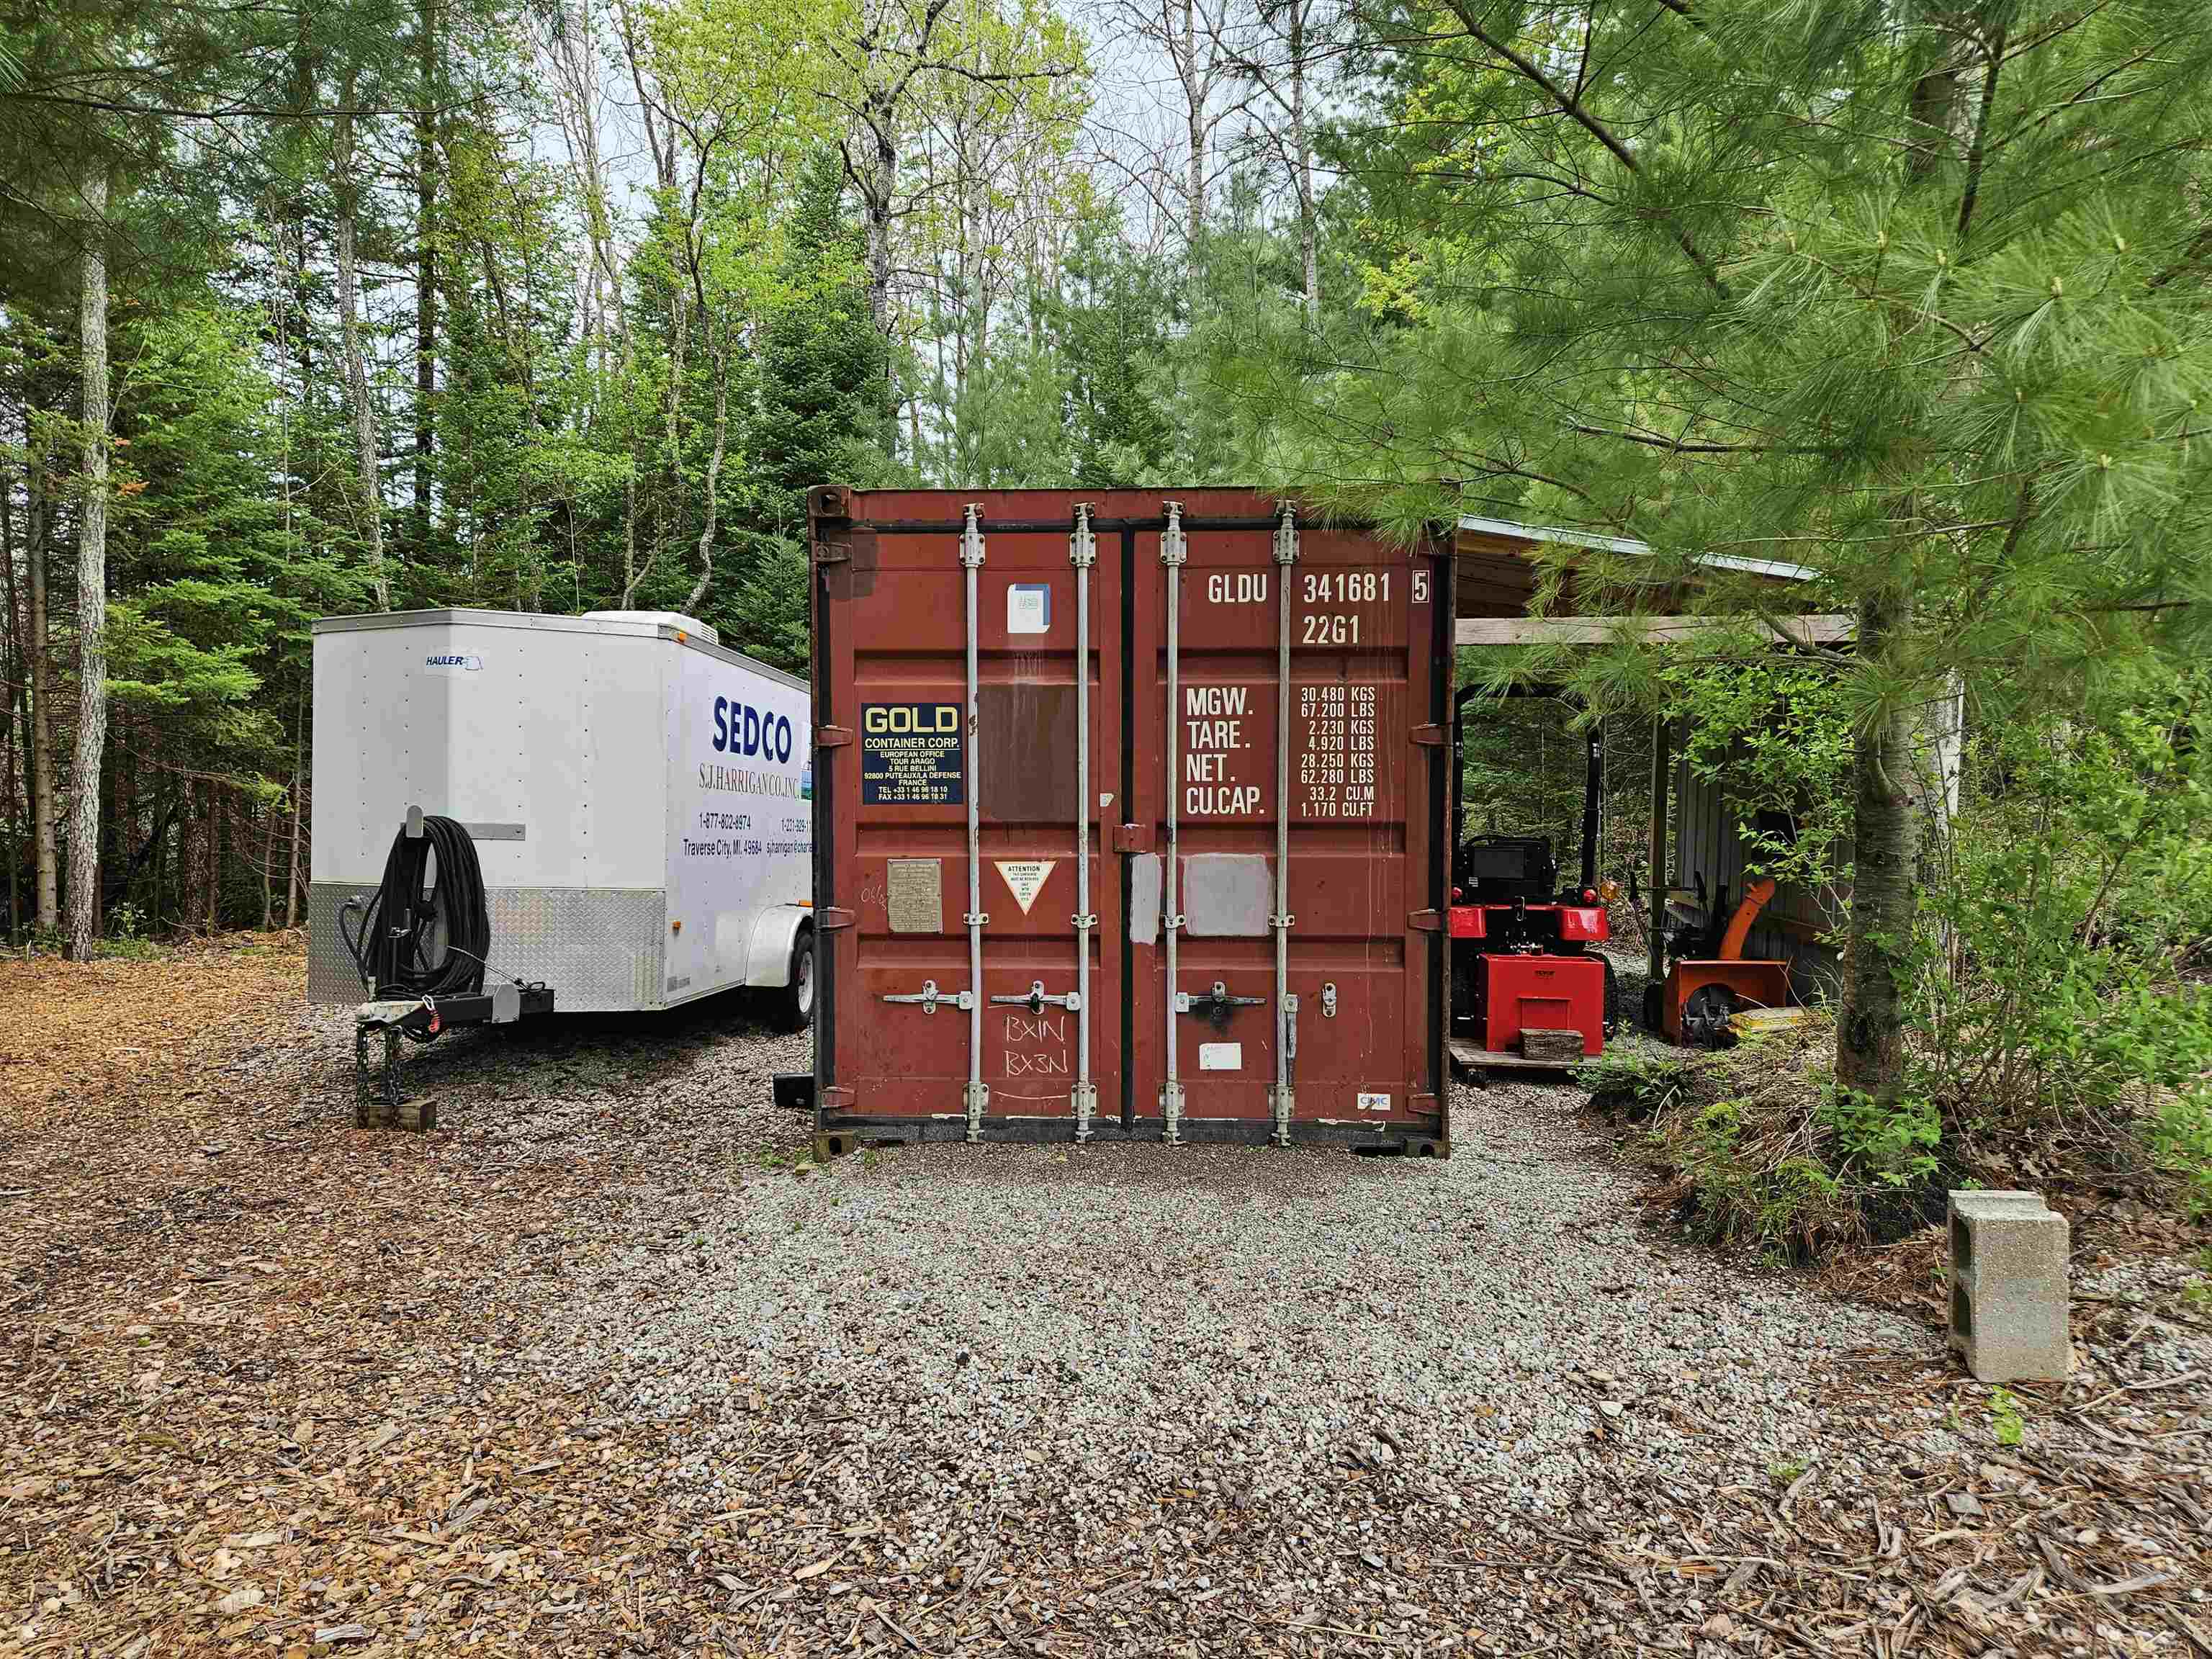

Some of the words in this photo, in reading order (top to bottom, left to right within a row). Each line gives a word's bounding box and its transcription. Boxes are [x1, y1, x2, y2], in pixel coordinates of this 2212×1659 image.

[1208, 574, 1267, 603] GLDU
[1303, 572, 1389, 603] 341681
[1414, 572, 1427, 601] 5
[1302, 615, 1359, 644] 22G1
[426, 656, 464, 665] HAULER
[1186, 688, 1254, 715] MGW.
[1301, 687, 1344, 701] 30.480
[1351, 687, 1375, 701] KGS
[1301, 703, 1344, 717] 67.200
[1351, 703, 1375, 717] LBS
[866, 707, 958, 732] GOLD
[1309, 720, 1344, 734] 2.230
[1351, 720, 1375, 734] KGS
[712, 696, 791, 764] SEDCO
[1186, 721, 1251, 749] TARE.
[865, 737, 925, 748] CONTAINER
[928, 737, 960, 748] CORP.
[1308, 737, 1344, 750] 4.920
[1351, 737, 1374, 750] LBS
[1186, 754, 1236, 781] NET.
[1301, 753, 1344, 768] 28.250
[1351, 753, 1374, 768] KGS
[1301, 769, 1344, 783] 62.280
[1351, 769, 1374, 783] LBS
[1186, 787, 1265, 814] CU.CAP.
[1310, 787, 1336, 801] 33.2
[1346, 786, 1374, 801] CU.M
[1301, 803, 1336, 817] 1.170
[1342, 802, 1374, 817] CU.FT
[683, 839, 715, 855] Traverse
[716, 840, 732, 858] City,
[744, 840, 762, 855] 49684
[1004, 1050, 1068, 1077] BX3N
